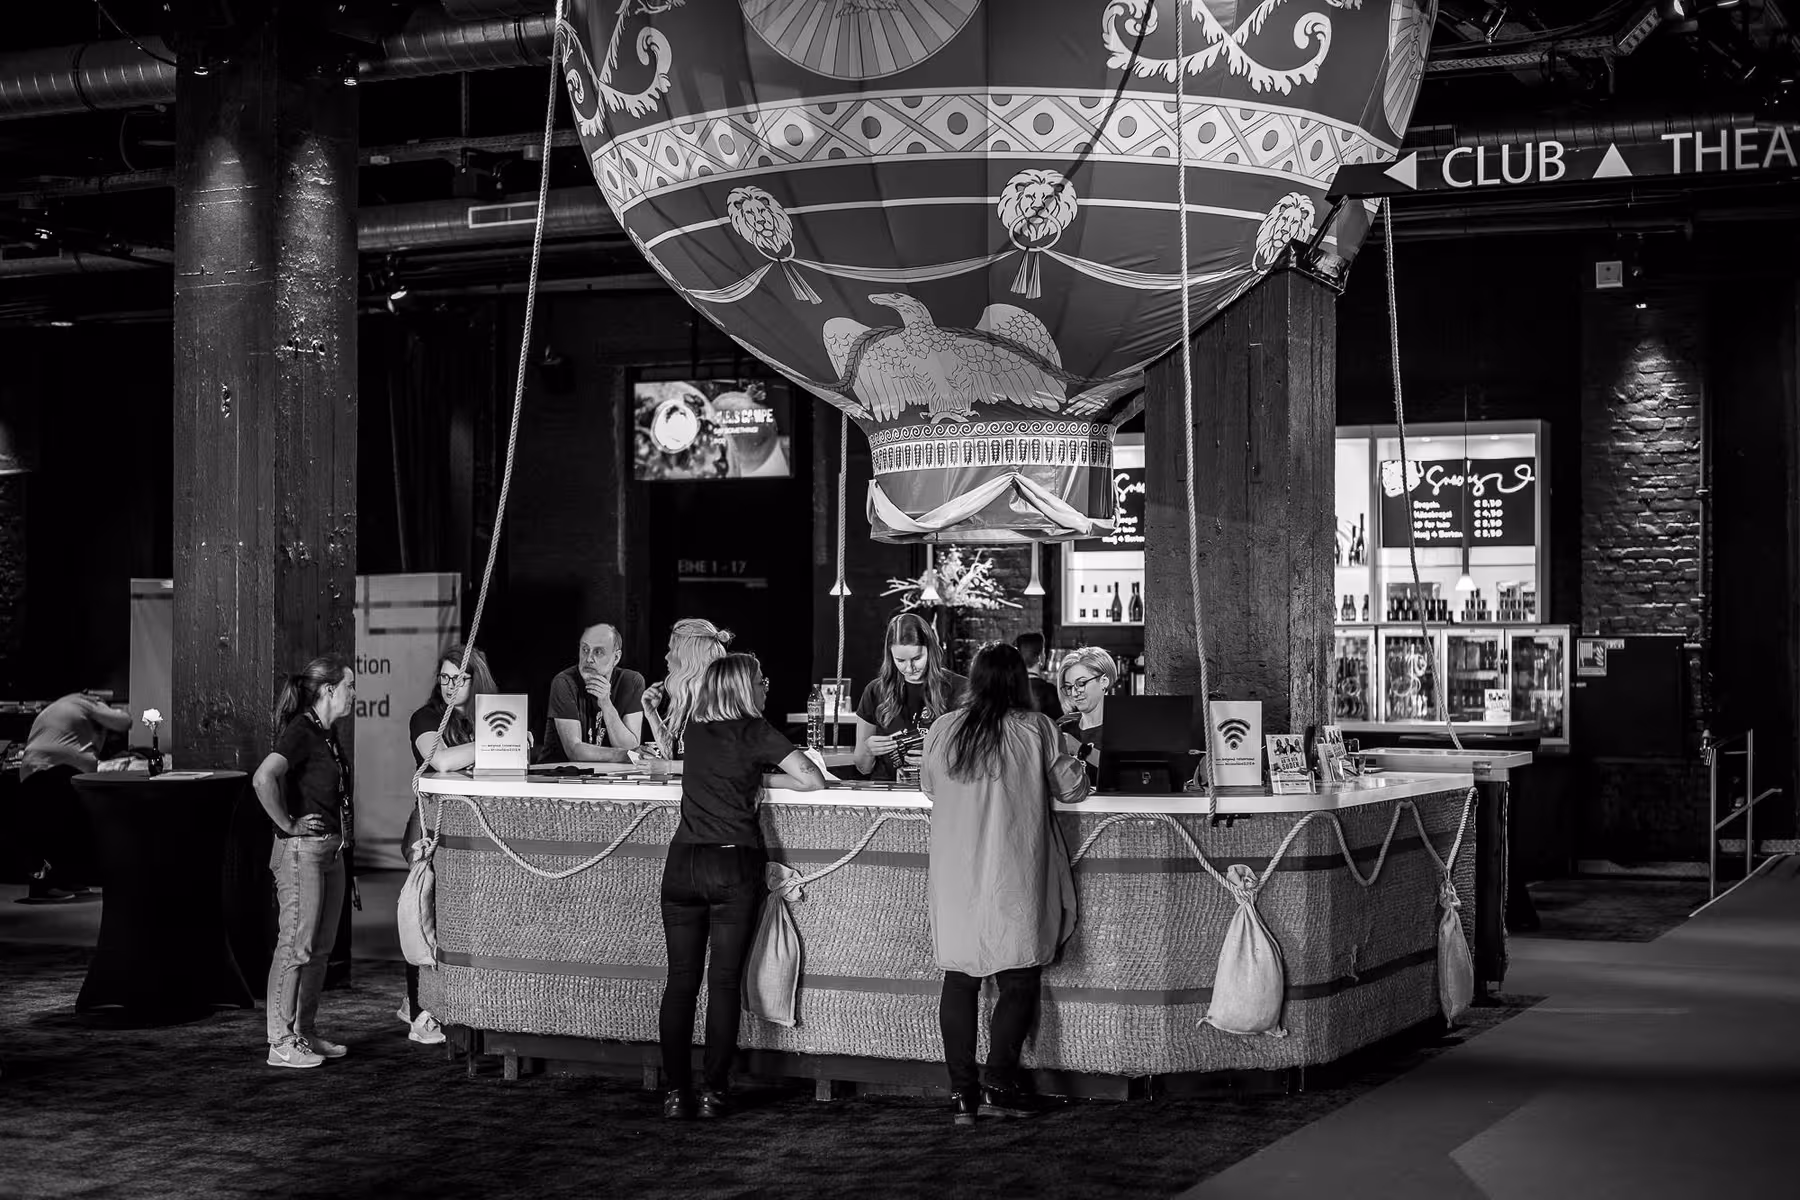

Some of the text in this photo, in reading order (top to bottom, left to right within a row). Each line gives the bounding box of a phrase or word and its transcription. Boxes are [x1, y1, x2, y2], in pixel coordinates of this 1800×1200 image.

[1442, 126, 1800, 188] CLUB THEA
[356, 653, 391, 675] tion
[355, 694, 390, 718] ard
